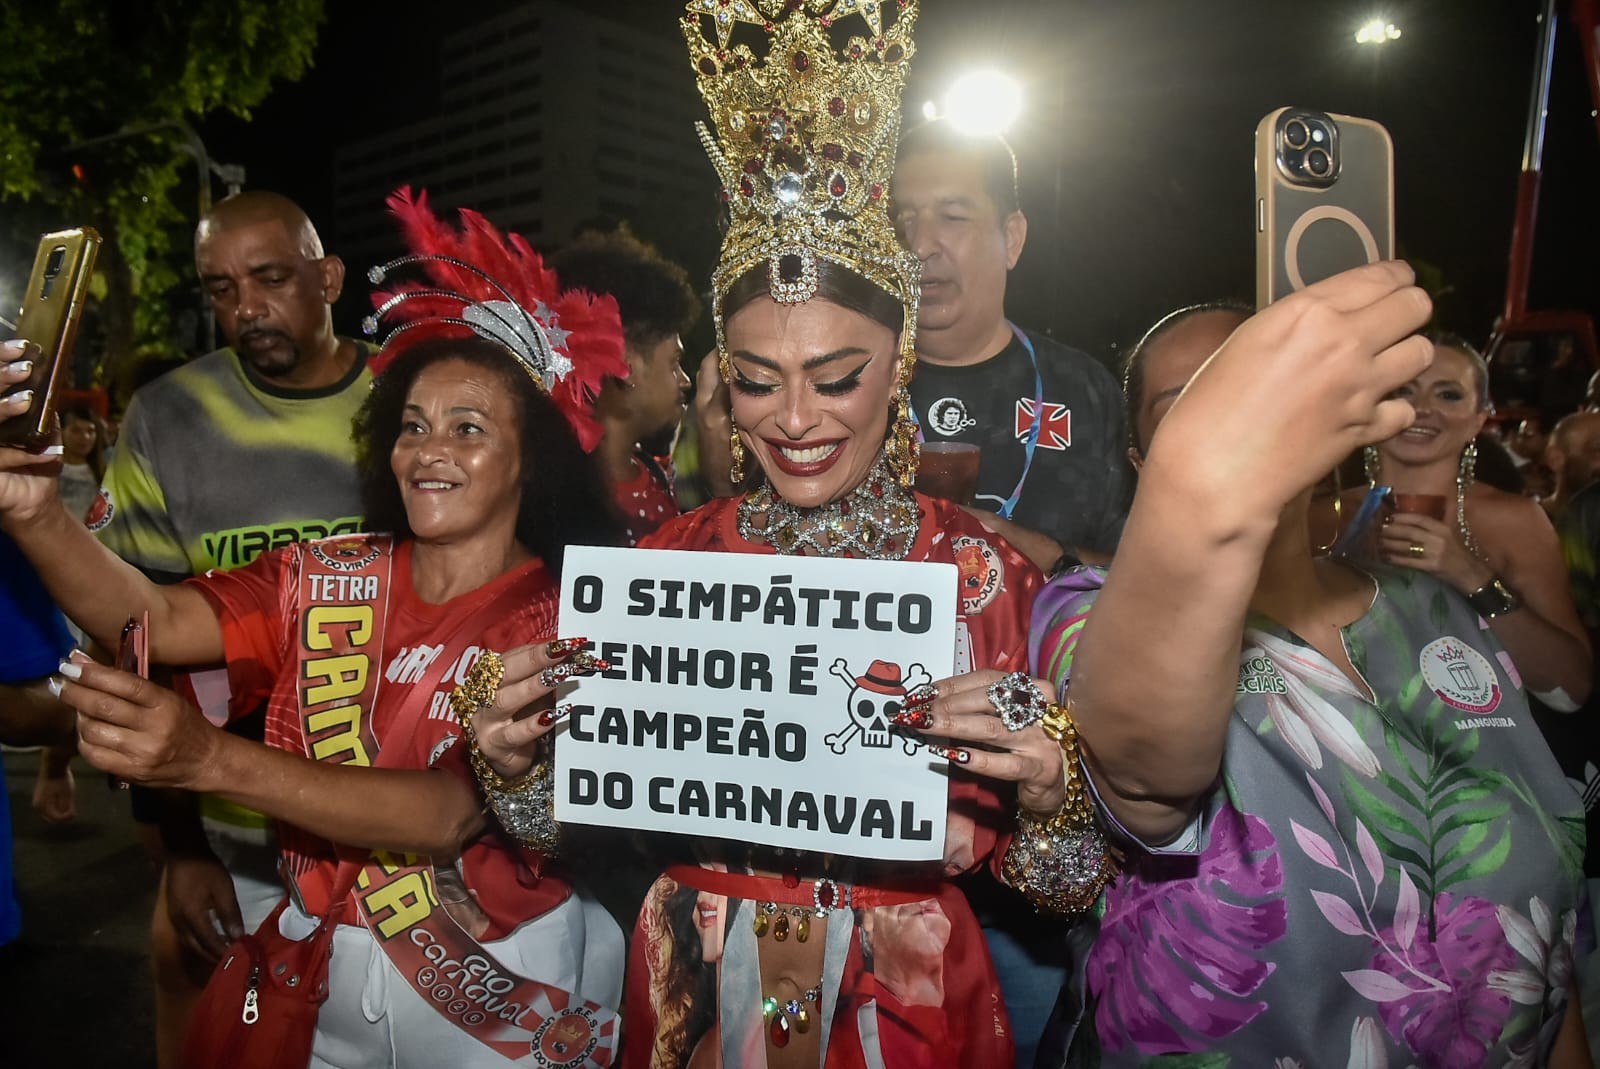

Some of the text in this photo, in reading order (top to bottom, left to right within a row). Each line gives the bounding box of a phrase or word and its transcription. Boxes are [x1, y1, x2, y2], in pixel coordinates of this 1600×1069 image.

[308, 574, 379, 601] TETRA
[573, 574, 932, 635] O SIMPÁTICO
[789, 643, 818, 696] É
[569, 704, 807, 762] CAMPEÃO
[1453, 716, 1517, 731] MANGUEIRA
[569, 768, 933, 841] DO CARNAVAL
